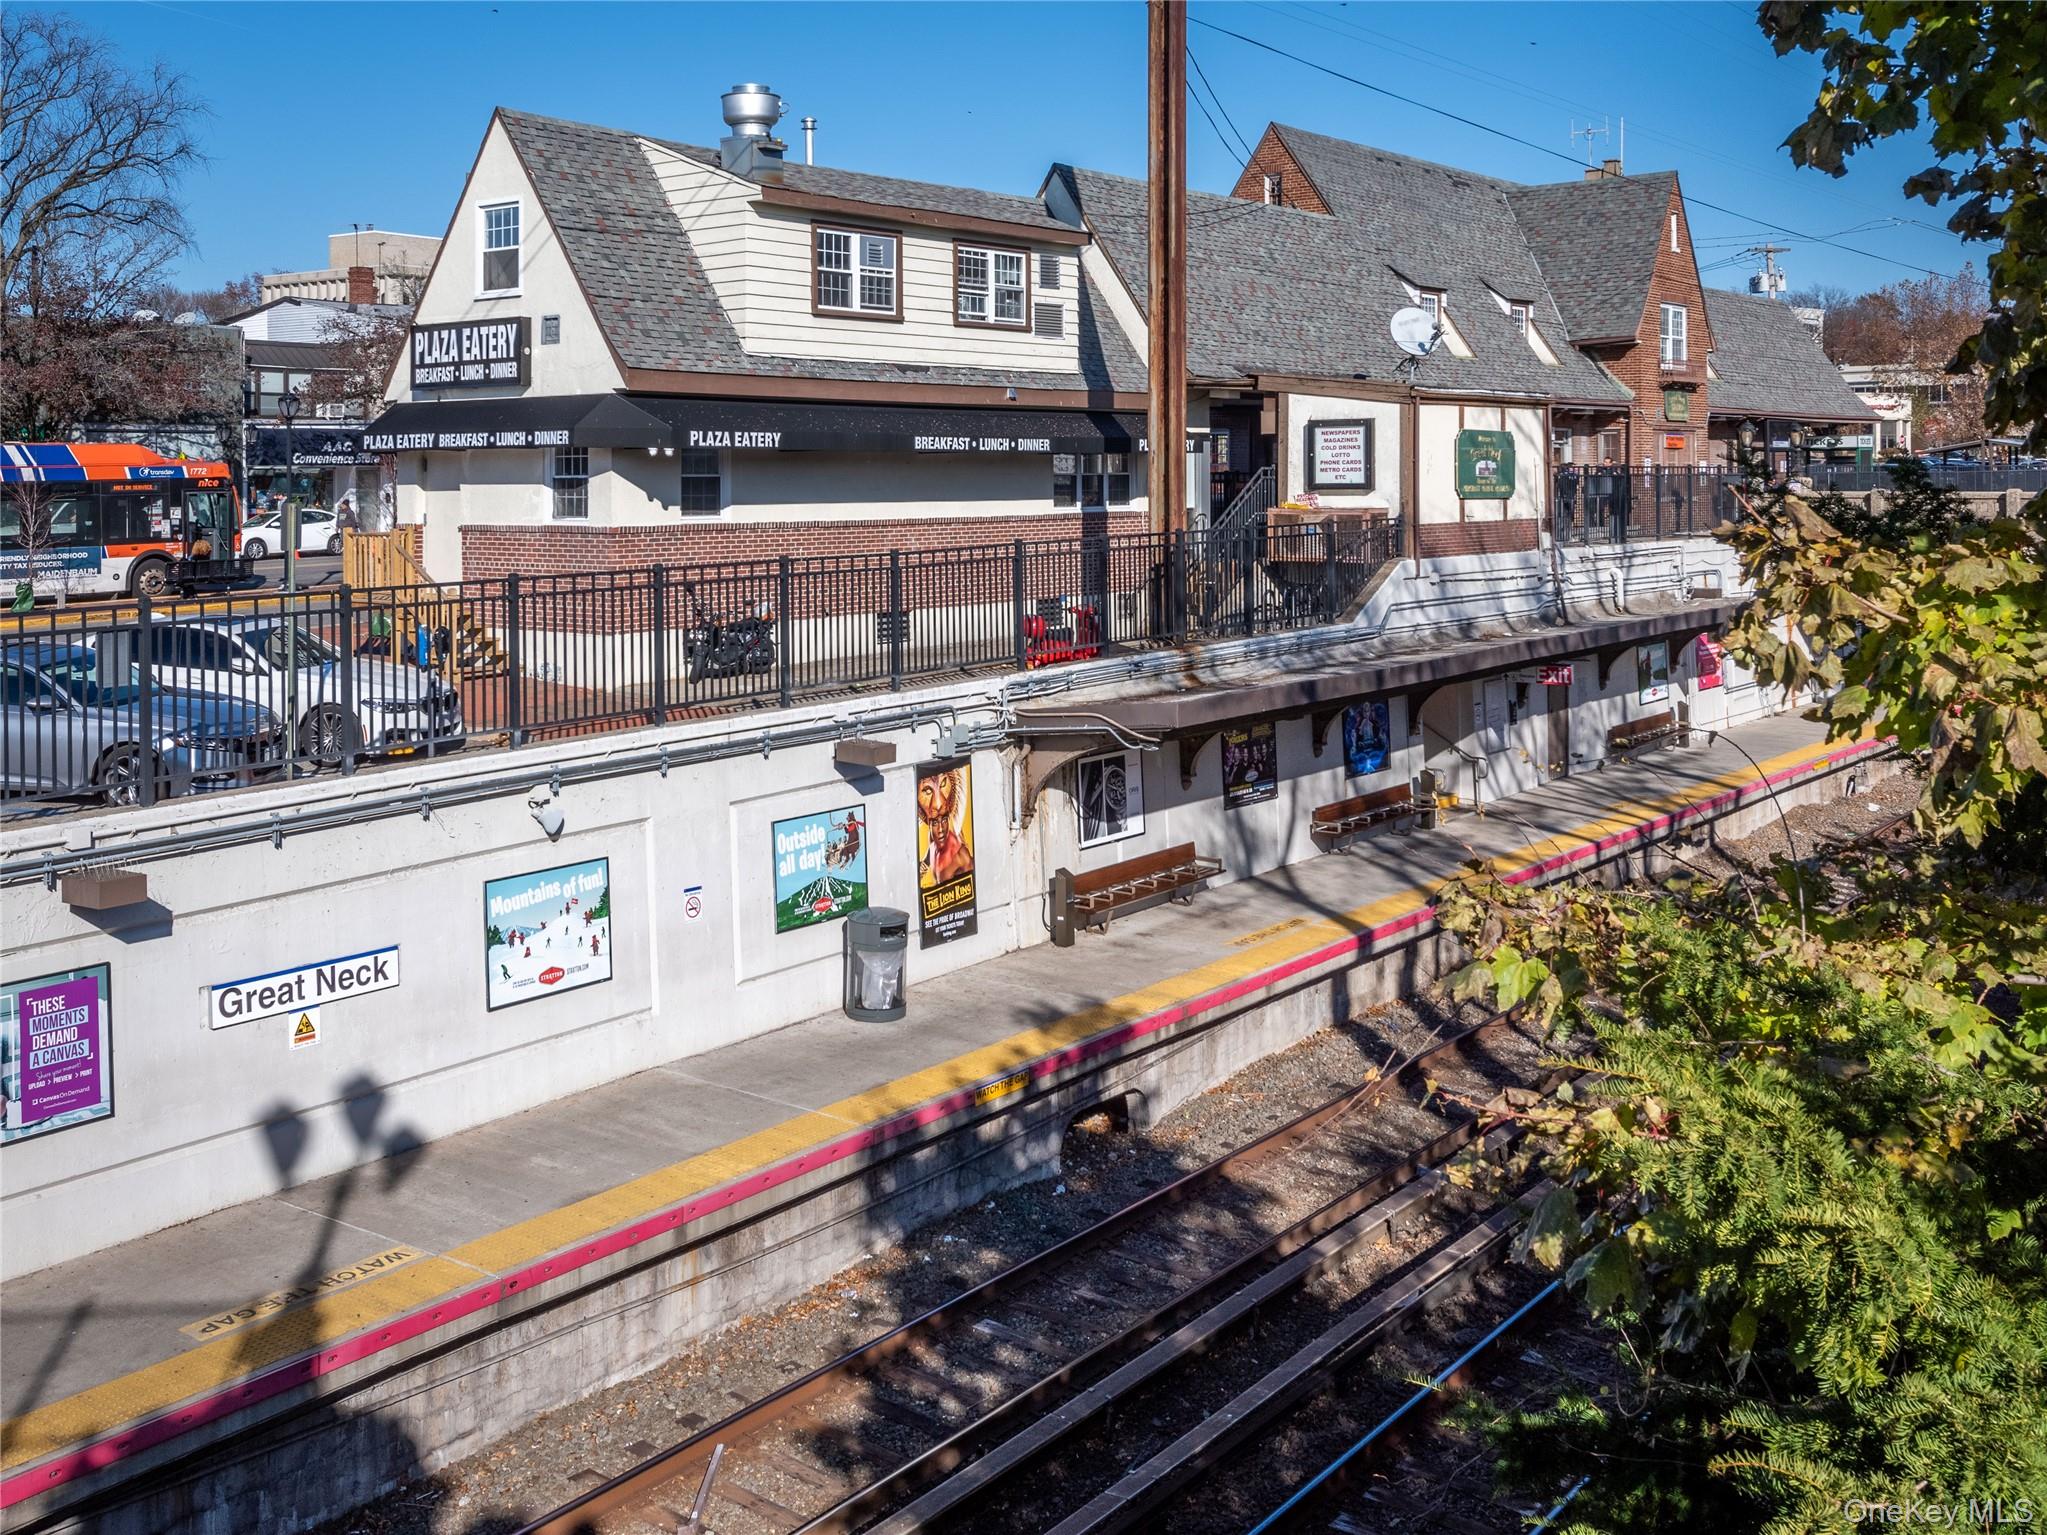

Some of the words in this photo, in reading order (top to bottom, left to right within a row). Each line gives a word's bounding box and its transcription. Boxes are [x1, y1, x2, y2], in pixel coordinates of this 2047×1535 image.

[415, 329, 459, 365] PLAZA
[462, 323, 518, 361] EATERY
[415, 366, 455, 384] BREAKFAST
[460, 364, 484, 381] LUNCH
[489, 361, 518, 379] DINNER
[321, 441, 353, 452] AAC
[363, 434, 395, 450] PLAZA
[396, 432, 436, 449] EATERY
[438, 432, 488, 448] BREAKFAST
[496, 431, 526, 446] LUNCH
[534, 430, 569, 445] DINNER
[690, 430, 731, 447] PLAZA
[734, 431, 781, 448] EATERY
[914, 436, 970, 450] BREAKFAST
[979, 437, 1009, 451] LUNCH
[1017, 438, 1050, 451] DINNER
[292, 452, 355, 464] Convenience
[355, 452, 381, 464] Store
[149, 468, 175, 476] transdev
[189, 467, 208, 476] 1772
[197, 478, 220, 488] nice
[1536, 666, 1570, 683] Exit
[777, 823, 826, 855] Outside
[779, 852, 796, 877] all
[799, 843, 826, 872] day!
[489, 880, 562, 918] Mountains
[562, 876, 577, 898] of
[577, 867, 604, 893] fun!
[926, 897, 940, 912] THE
[939, 890, 955, 907] LION
[954, 884, 972, 901] KING
[218, 973, 306, 1019] Great
[316, 955, 390, 997] Neck
[31, 994, 66, 1016] THESE
[32, 1007, 86, 1033] MOMENTS
[32, 1026, 78, 1051] DEMAND
[32, 1052, 40, 1068] A
[42, 1041, 85, 1065] CANVAS
[28, 1080, 46, 1090] UPLOAD
[53, 1073, 73, 1085] PREVIEW
[79, 1068, 93, 1078] PRINT
[975, 1084, 1000, 1100] WATCH
[1000, 1079, 1014, 1090] THE
[1015, 1071, 1030, 1084] GAP
[315, 1250, 412, 1289] WATCH
[199, 1308, 258, 1334] GAP
